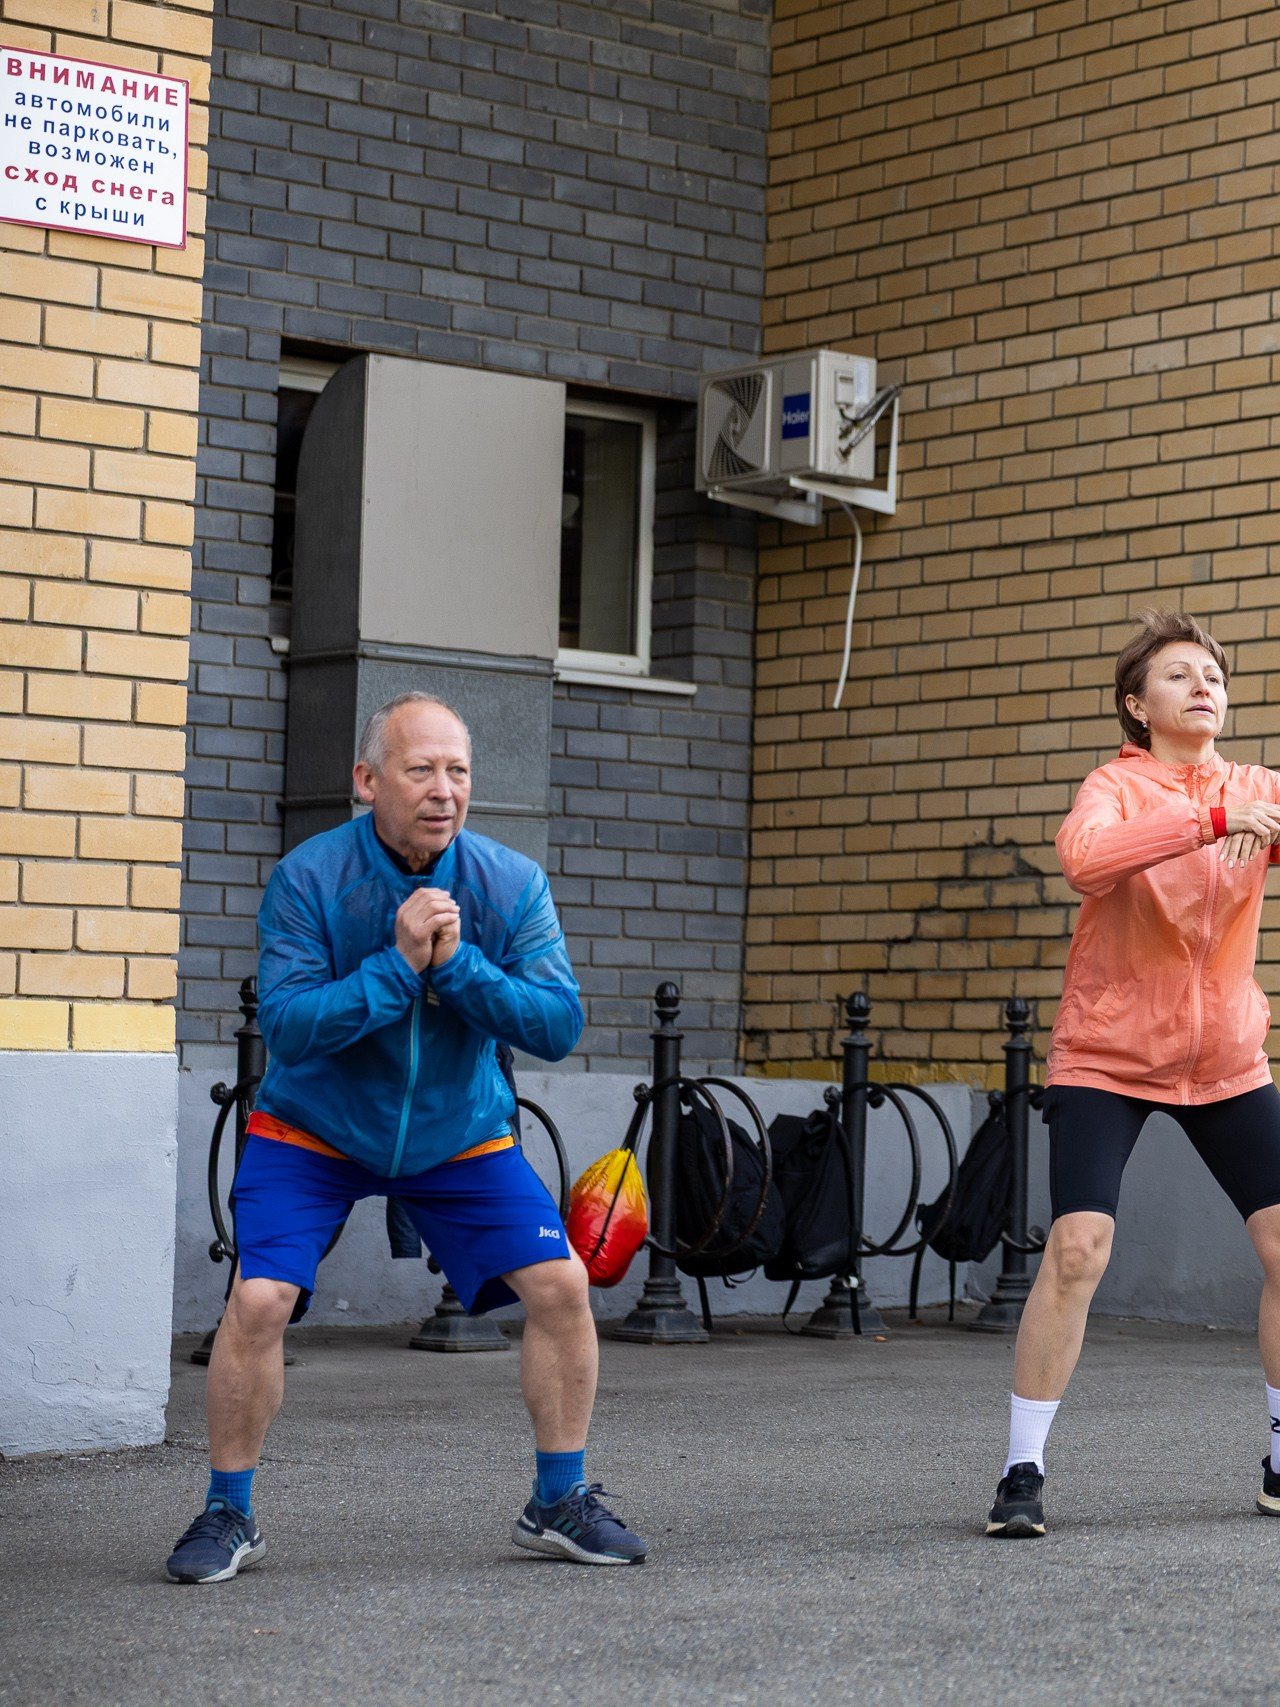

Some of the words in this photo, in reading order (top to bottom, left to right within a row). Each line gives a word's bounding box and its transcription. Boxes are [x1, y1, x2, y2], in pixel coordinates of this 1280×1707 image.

[6, 57, 179, 107] ВНИМАНИЕ
[14, 90, 170, 132] автомобили
[4, 113, 32, 130] не
[43, 119, 178, 160] парковать,
[28, 140, 155, 175] возможен
[4, 164, 78, 193] сход
[91, 179, 175, 206] снега
[35, 197, 47, 211] с
[59, 199, 145, 227] крыши
[782, 409, 809, 425] Haier
